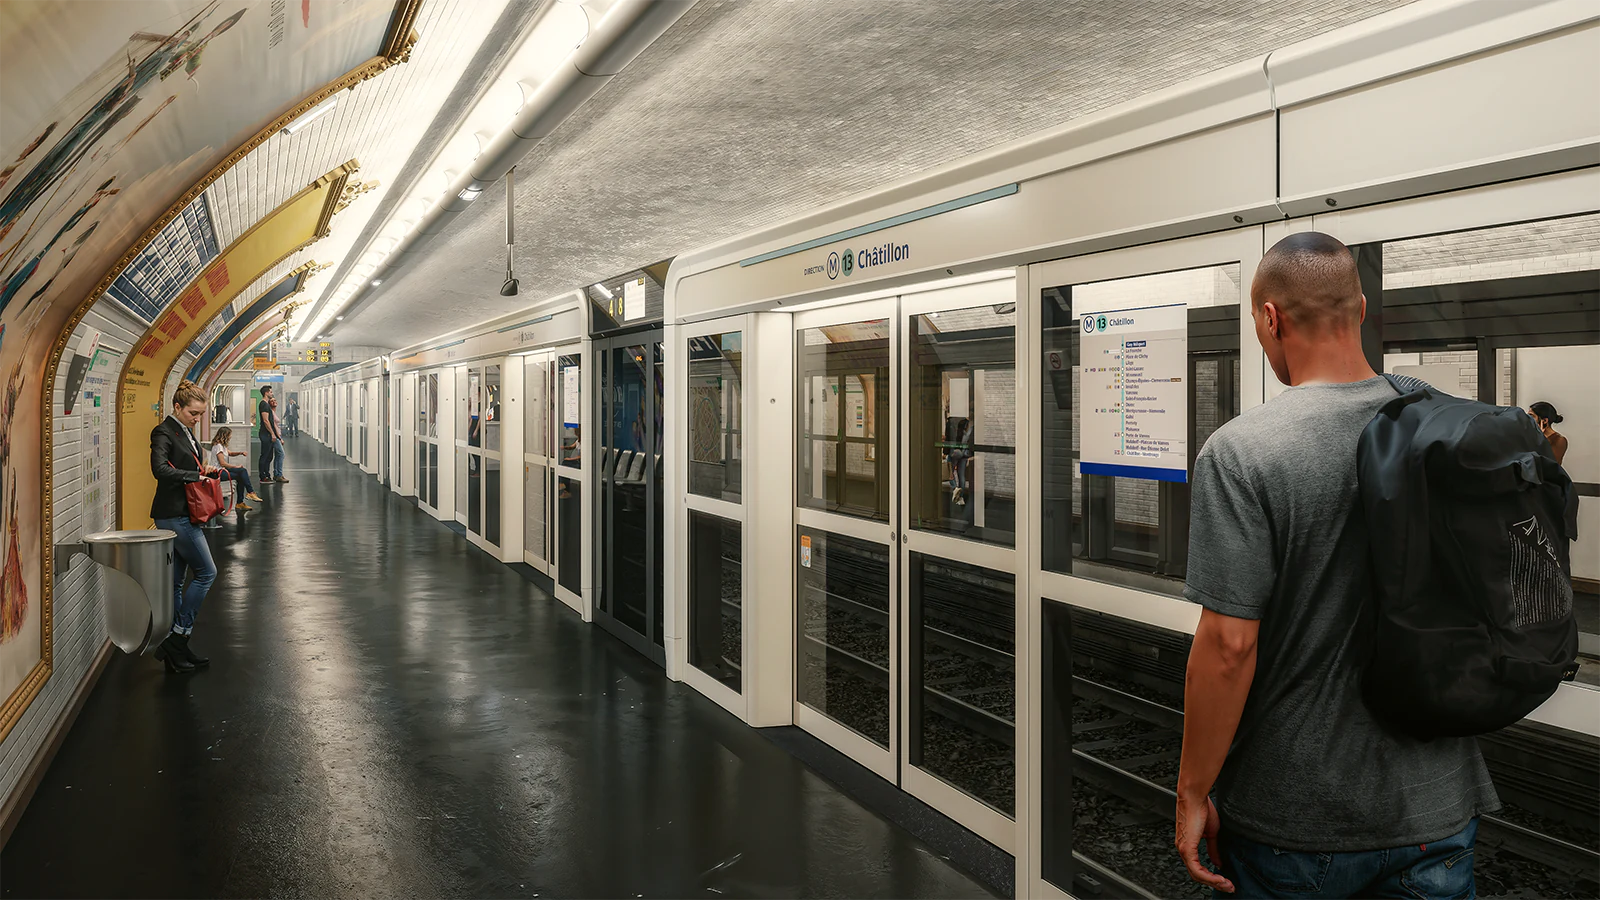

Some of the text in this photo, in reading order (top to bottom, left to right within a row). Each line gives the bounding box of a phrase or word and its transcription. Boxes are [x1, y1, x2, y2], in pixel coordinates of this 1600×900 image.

[804, 266, 824, 276] DIRECTION
[843, 254, 853, 271] 13
[858, 242, 909, 268] Châtillon
[1097, 318, 1106, 330] 13
[1109, 318, 1134, 327] Châtillon
